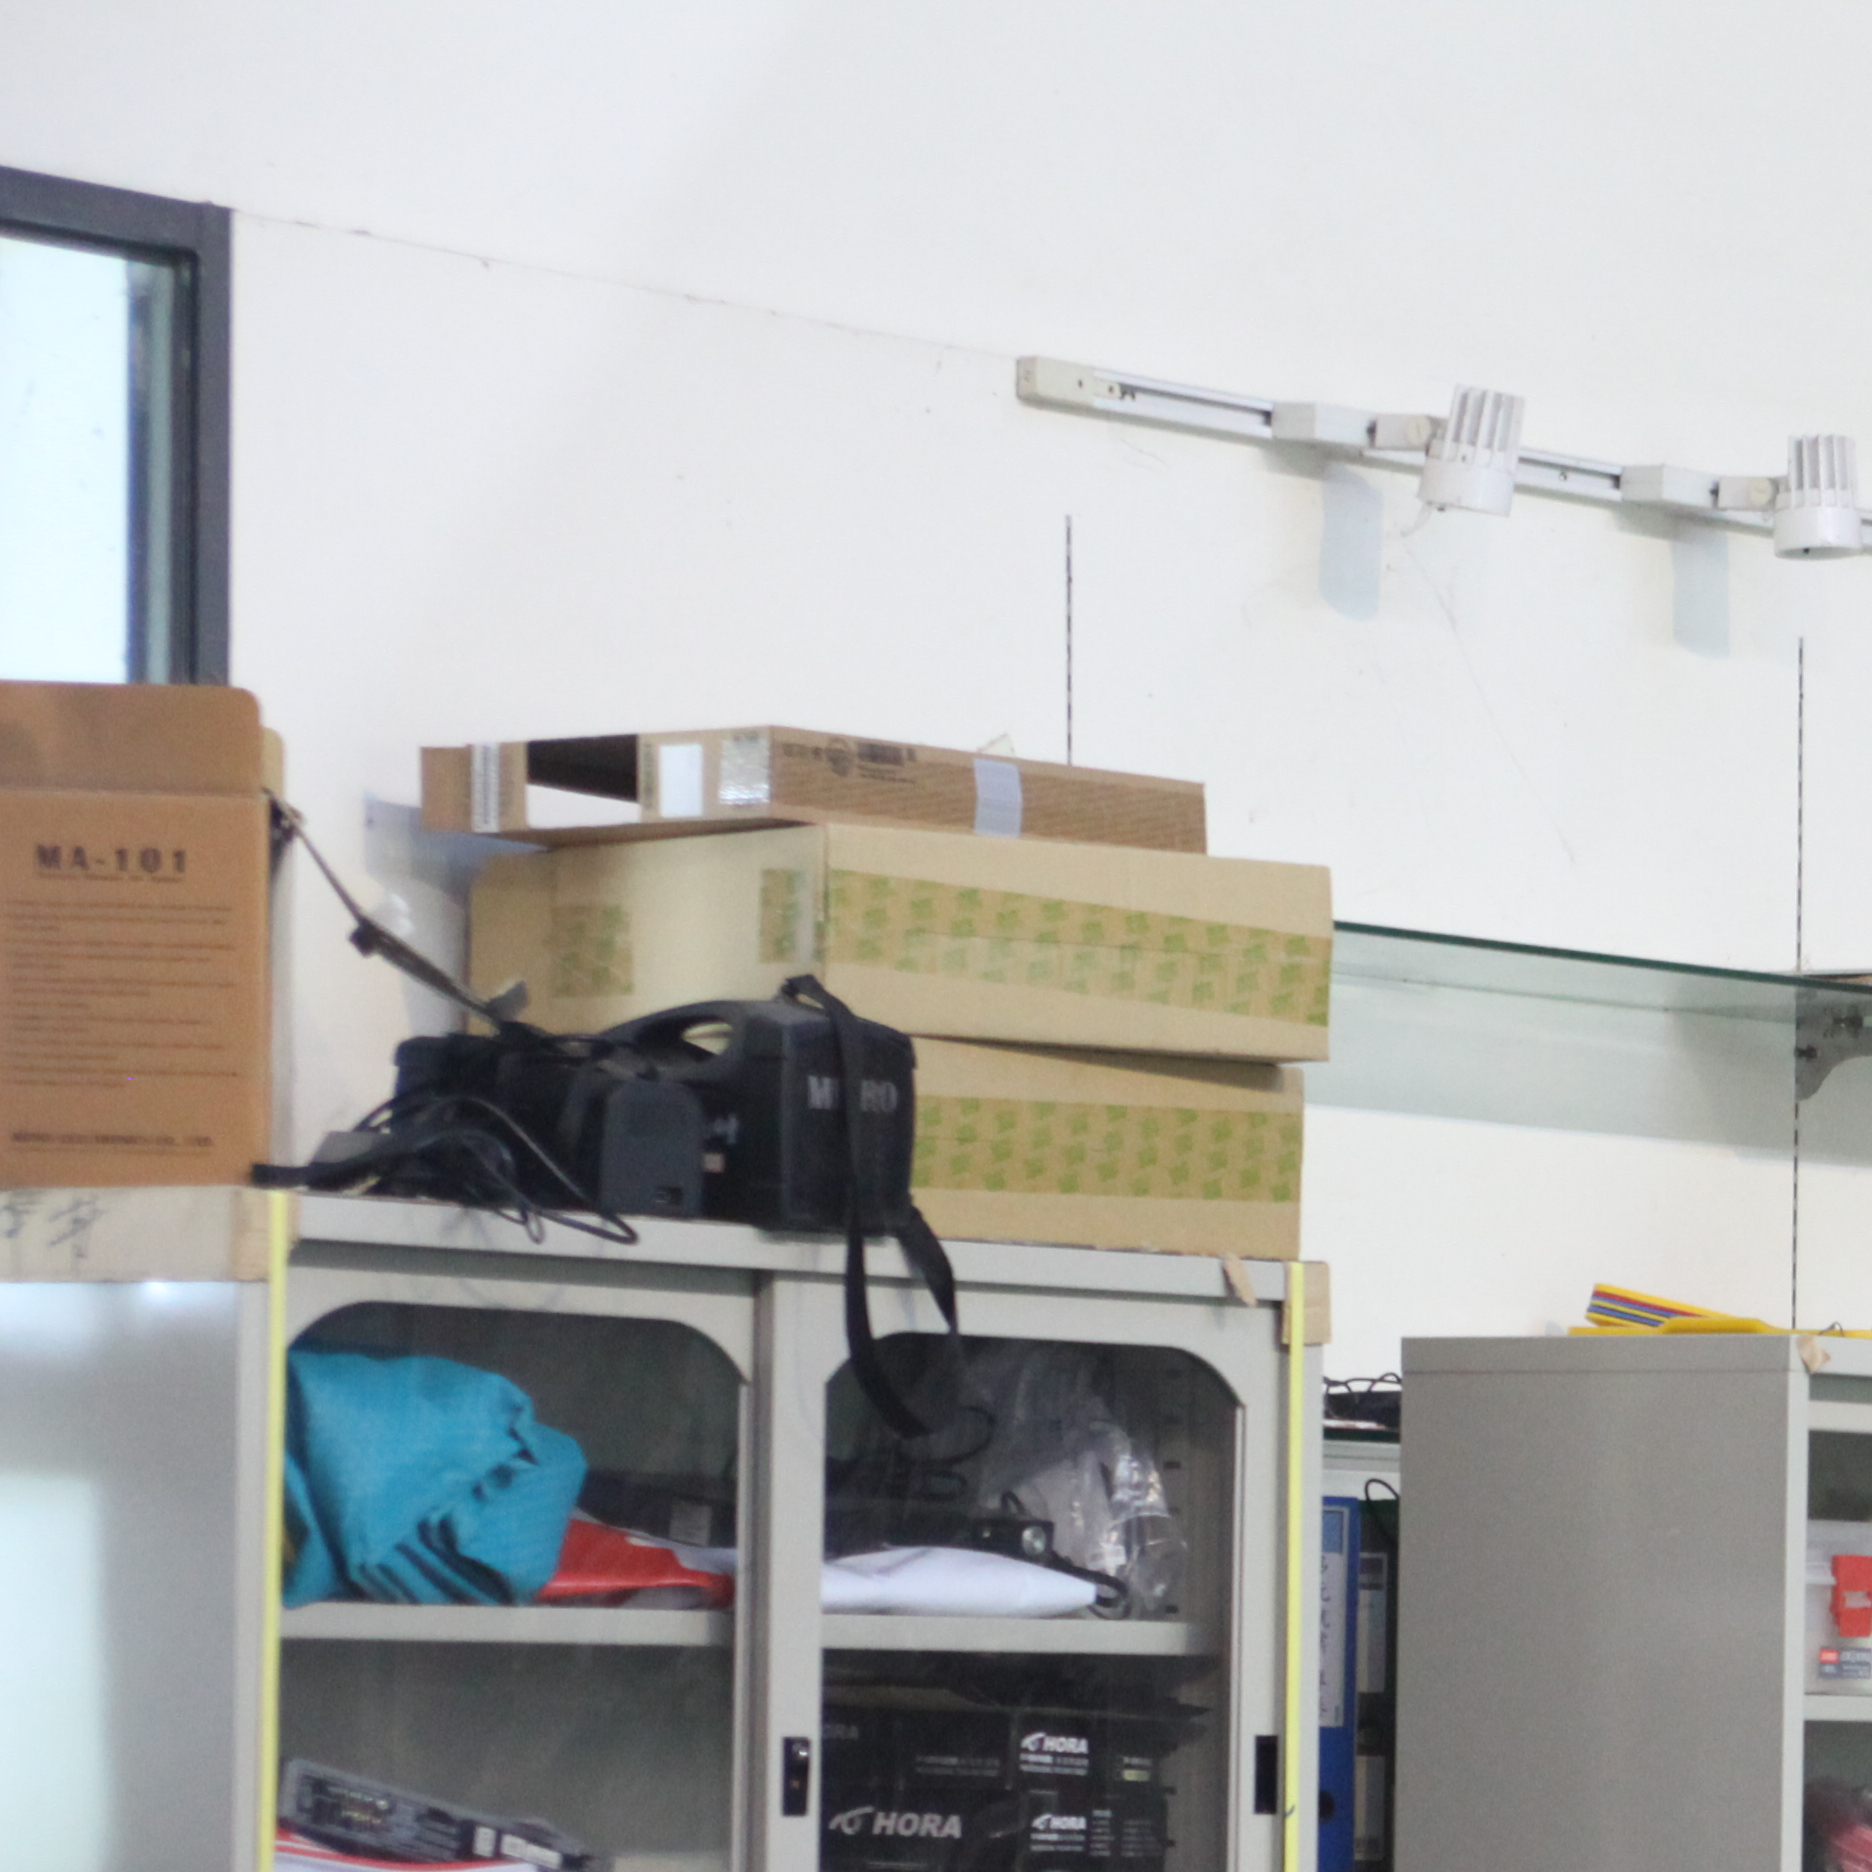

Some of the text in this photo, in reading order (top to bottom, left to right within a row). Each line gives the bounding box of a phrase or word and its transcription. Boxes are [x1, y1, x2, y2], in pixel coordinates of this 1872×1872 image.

[36, 843, 187, 874] MA-101
[1042, 1734, 1089, 1755] HORA
[872, 1811, 962, 1839] HORA
[1050, 1816, 1087, 1831] HORA
